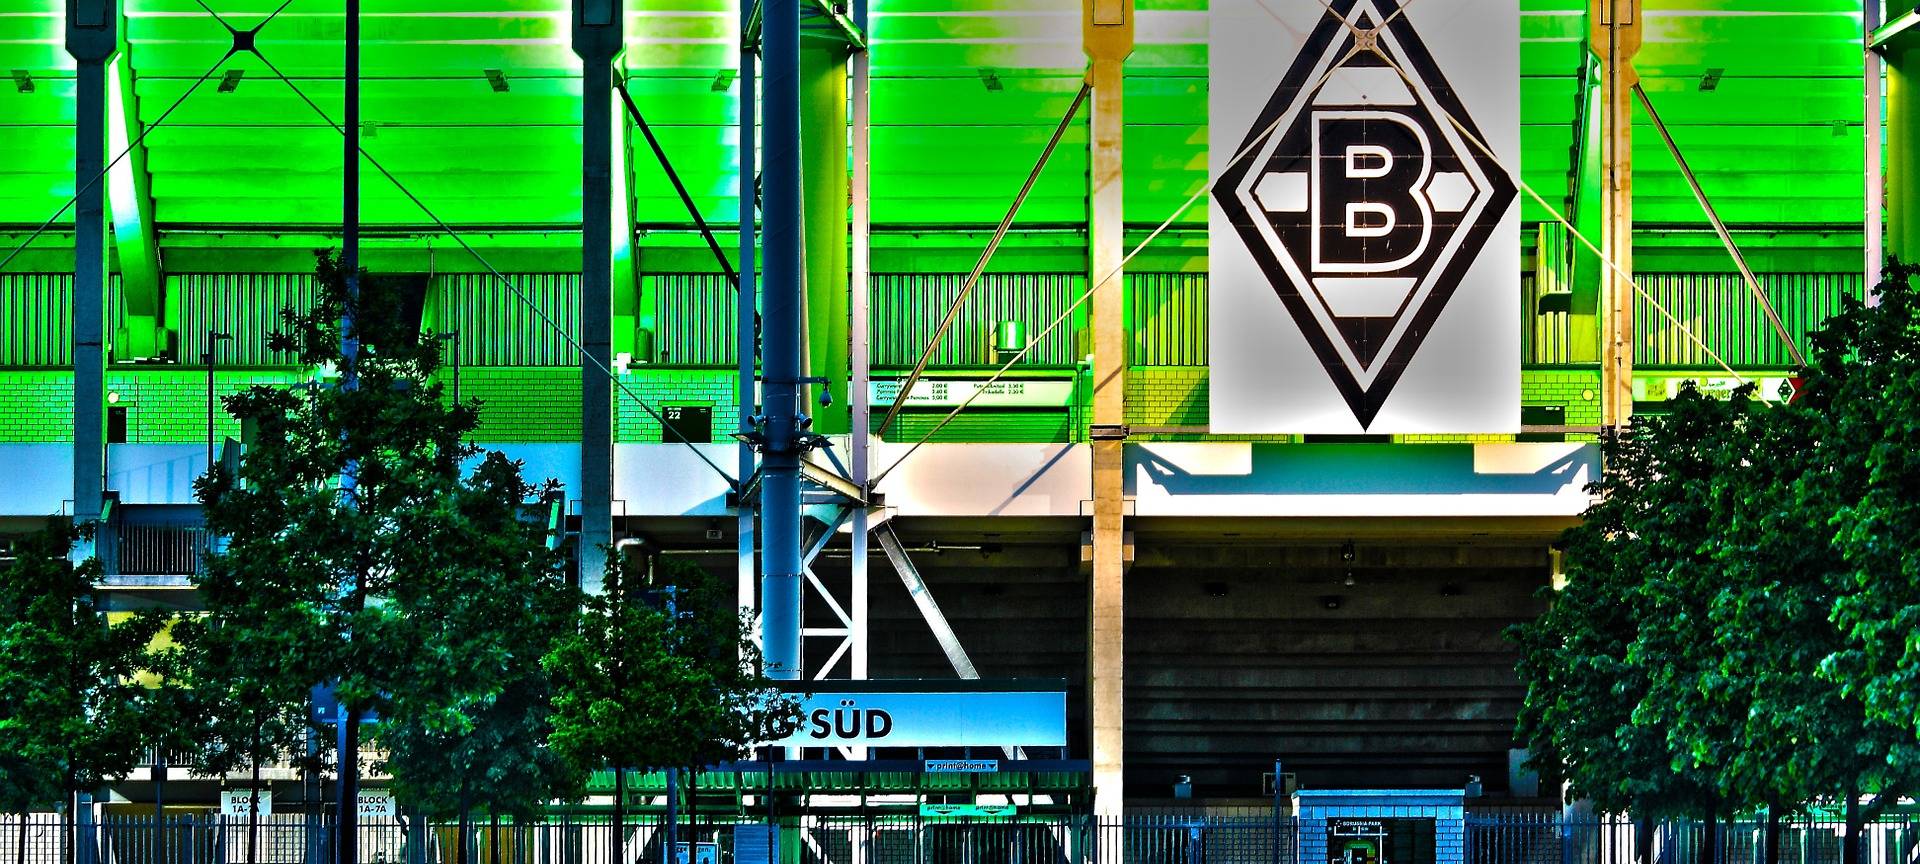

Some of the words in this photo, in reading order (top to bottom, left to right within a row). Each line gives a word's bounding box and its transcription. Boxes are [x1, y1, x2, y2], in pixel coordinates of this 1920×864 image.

[1311, 110, 1433, 273] B
[668, 411, 681, 420] 22
[810, 699, 893, 739] SÜD
[936, 761, 986, 770] print@home
[358, 796, 388, 804] BLOCK
[359, 805, 387, 813] 1A-7A
